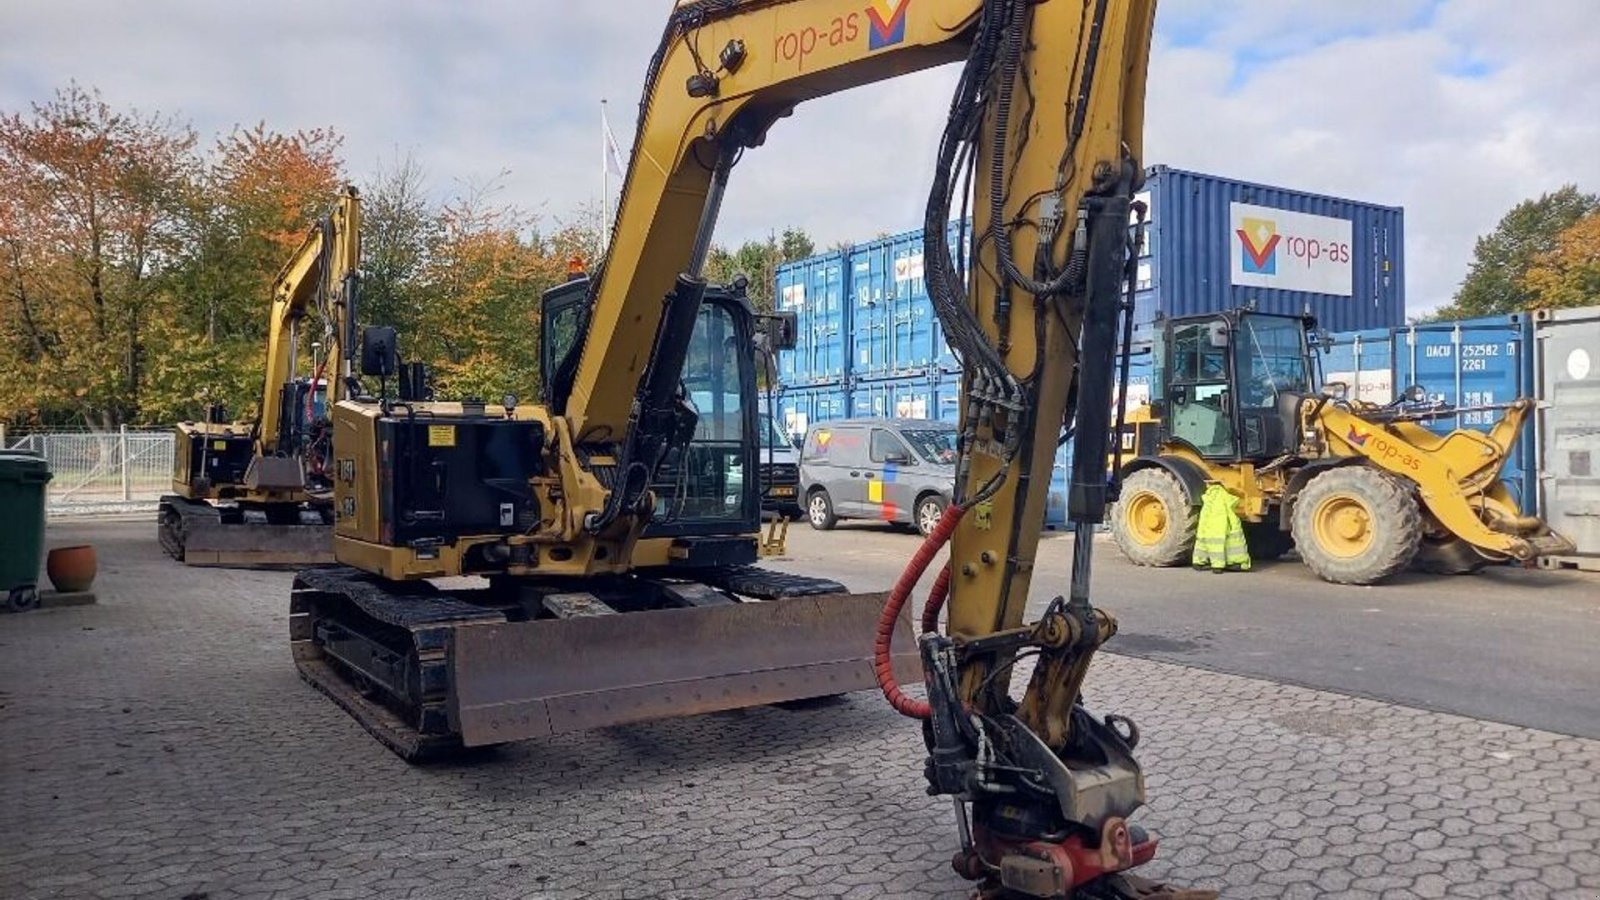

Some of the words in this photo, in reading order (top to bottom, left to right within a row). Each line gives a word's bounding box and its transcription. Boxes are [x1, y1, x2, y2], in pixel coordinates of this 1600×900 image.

[774, 12, 859, 71] rop-as
[1286, 235, 1350, 269] rop-as
[1370, 436, 1422, 470] rop-as
